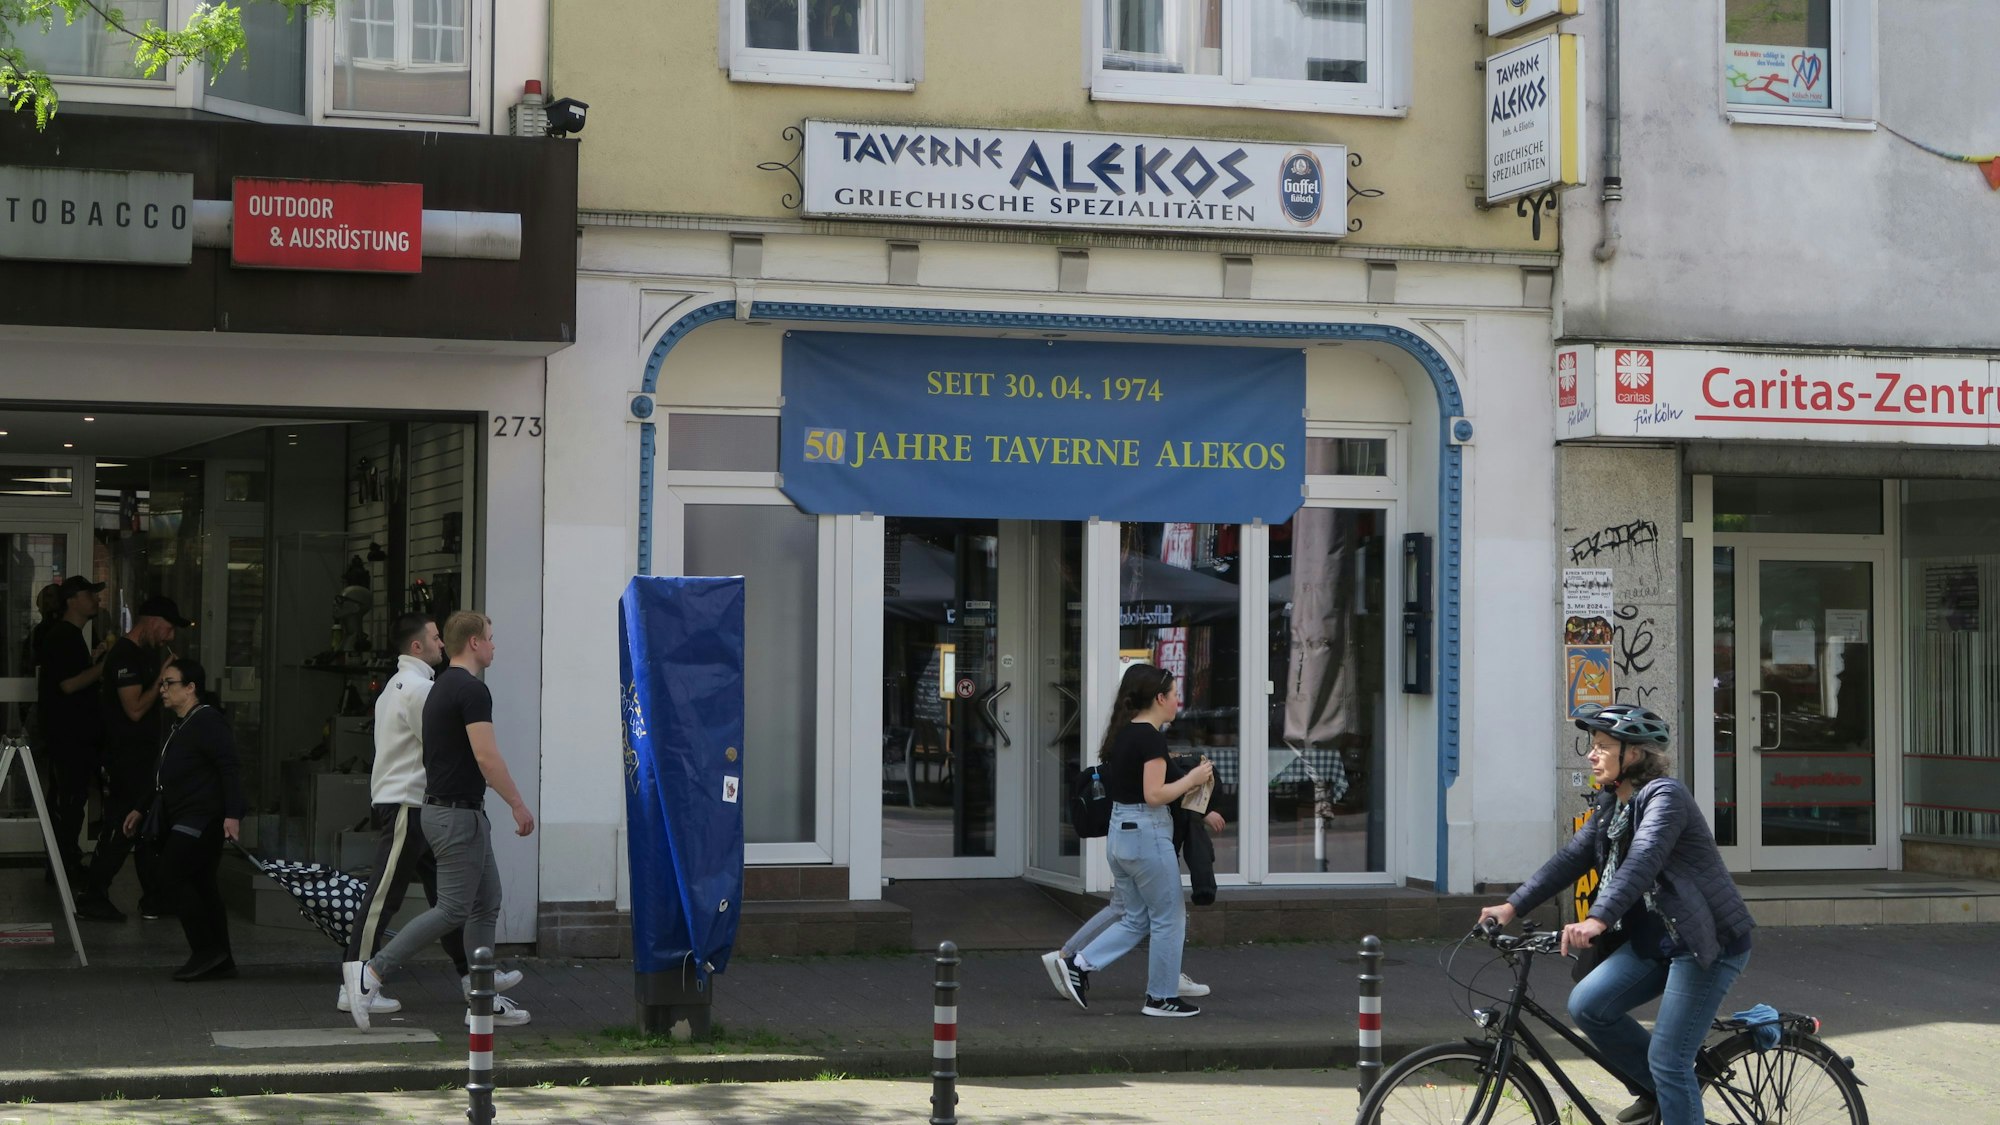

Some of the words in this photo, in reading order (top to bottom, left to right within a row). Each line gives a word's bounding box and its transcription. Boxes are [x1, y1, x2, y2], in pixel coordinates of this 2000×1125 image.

[1496, 54, 1540, 86] TAVERNE
[1491, 75, 1547, 124] ALEKOS
[834, 131, 1003, 170] TAVERNE
[1008, 139, 1256, 200] ALEKOS
[1493, 140, 1544, 167] GRIECHISCHE
[1492, 155, 1546, 184] SPEZIALITÄTEN
[1284, 178, 1320, 195] Gaffel
[6, 197, 187, 231] TOBACCO
[248, 195, 334, 219] OUTDOOR
[834, 187, 1035, 213] GRIECHISCHE
[1050, 196, 1256, 222] SPEZIALITÄTEN
[269, 227, 284, 247] &
[289, 226, 410, 252] AUSRÜSTUNG
[926, 371, 995, 397] SEIT
[1004, 374, 1043, 399] 30.
[1050, 375, 1092, 401] 04.
[1101, 377, 1164, 403] 1974
[1560, 396, 1576, 406] caritas
[1617, 391, 1651, 404] caritas
[494, 415, 543, 438] 273
[1633, 408, 1651, 433] für
[804, 430, 845, 461] 50
[849, 431, 972, 469] JAHRE
[985, 435, 1140, 467] TAVERNE
[1154, 440, 1286, 471] ALEKOS
